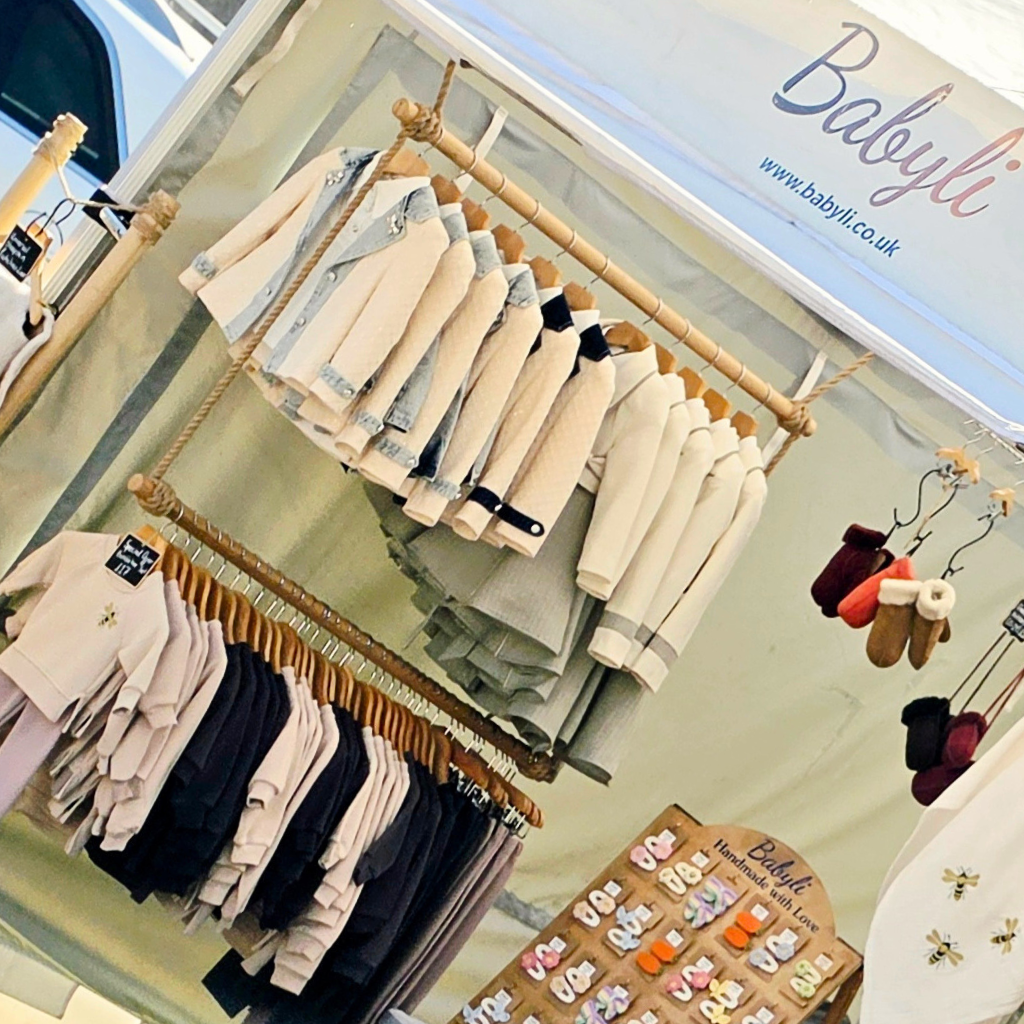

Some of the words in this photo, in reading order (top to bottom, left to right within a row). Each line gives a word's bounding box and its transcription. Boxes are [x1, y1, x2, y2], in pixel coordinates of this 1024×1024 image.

[759, 156, 901, 258] www.babyli.co.uk
[713, 838, 769, 890] Handmade
[769, 888, 793, 911] with
[792, 906, 820, 934] Love
[747, 839, 813, 896] Babyli
